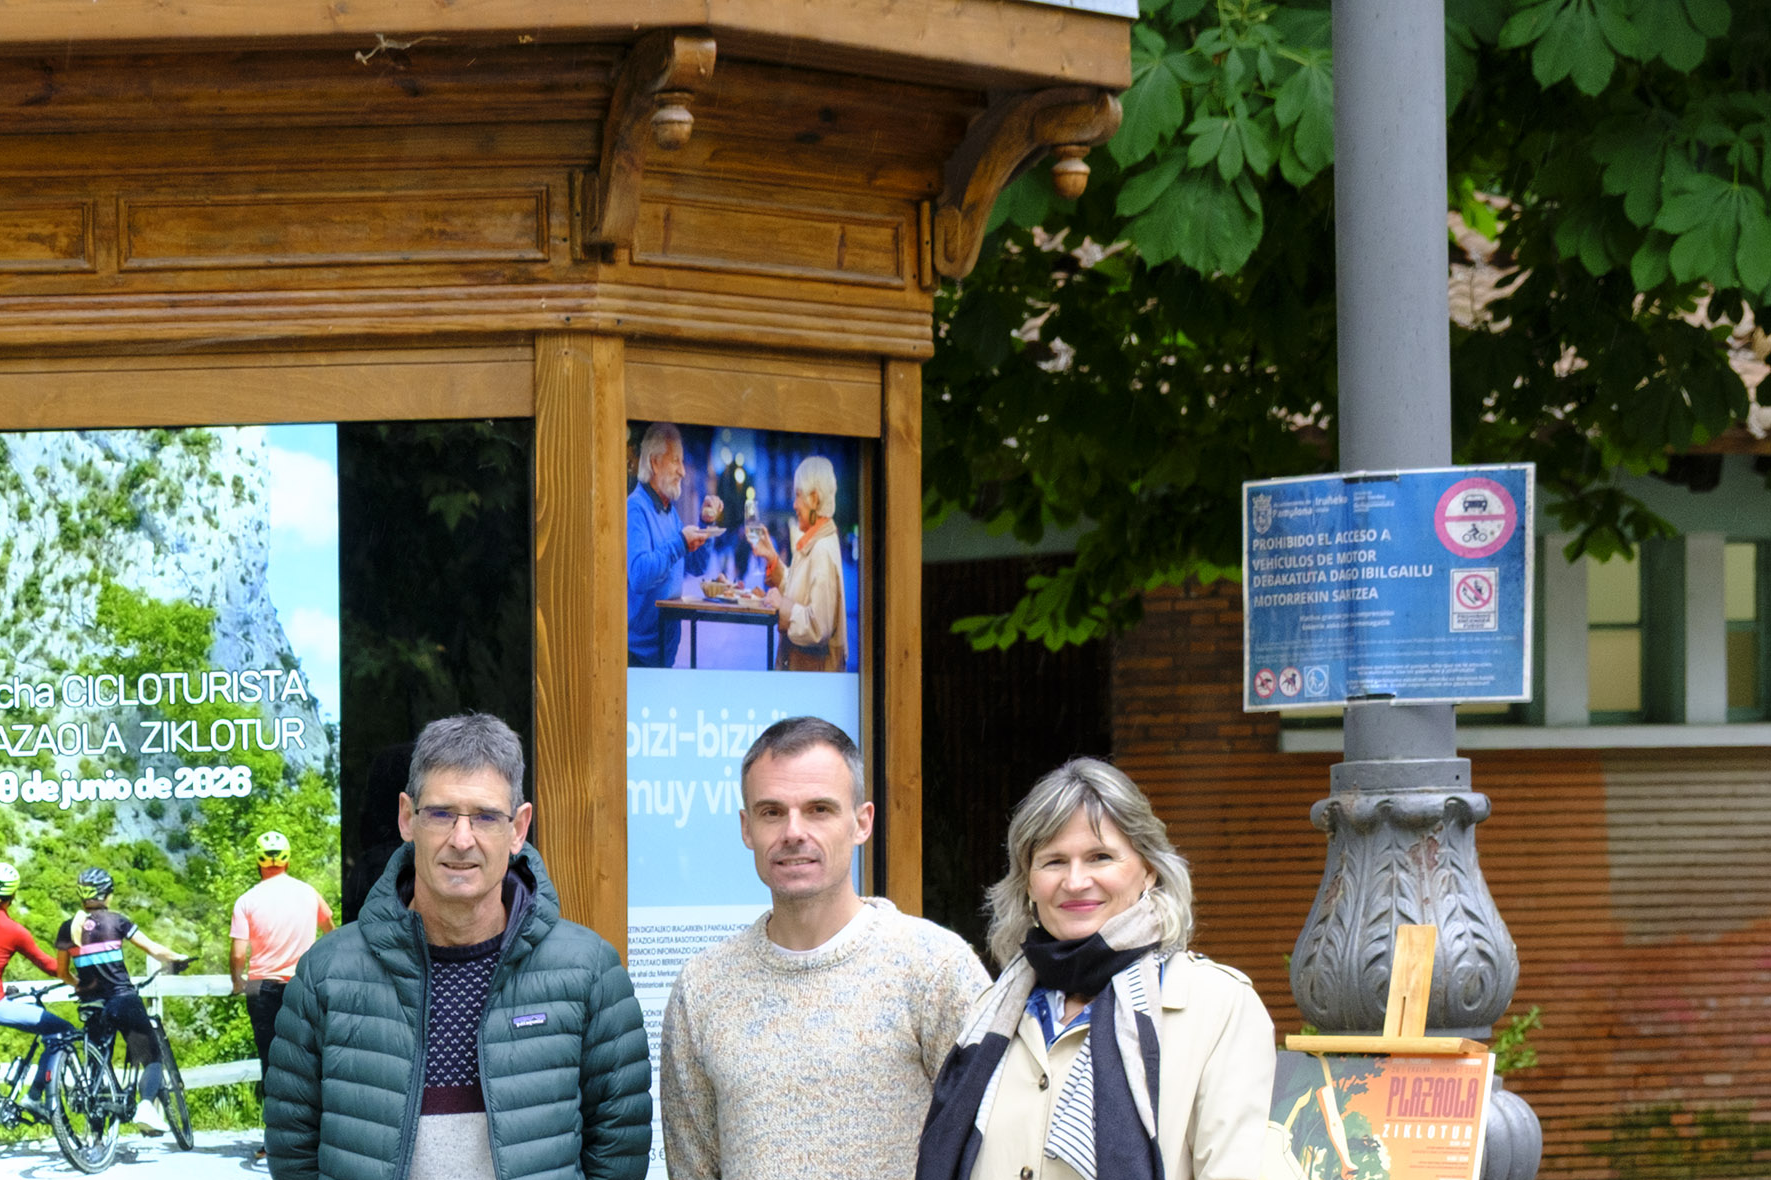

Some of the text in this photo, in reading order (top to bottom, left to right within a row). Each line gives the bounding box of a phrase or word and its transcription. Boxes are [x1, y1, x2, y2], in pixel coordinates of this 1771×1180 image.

[1252, 528, 1392, 551] PROHIBIDO EL ACCESO A
[1252, 549, 1377, 571] VEHÍCULOS DE MOTOR
[1253, 564, 1433, 588] DEBAKATUTA DAGO IBILGAILU
[1254, 586, 1379, 608] MOTORREKIN SARTZEA
[62, 669, 308, 709] CICLOTURISTA
[139, 717, 307, 754] ZIKLOTUR
[21, 768, 59, 801] de
[59, 768, 134, 810] junio
[135, 766, 173, 800] de
[174, 765, 253, 798] 2026
[1386, 1076, 1480, 1119] PLAZAOLA
[1381, 1123, 1473, 1140] ZIKLOTUR
